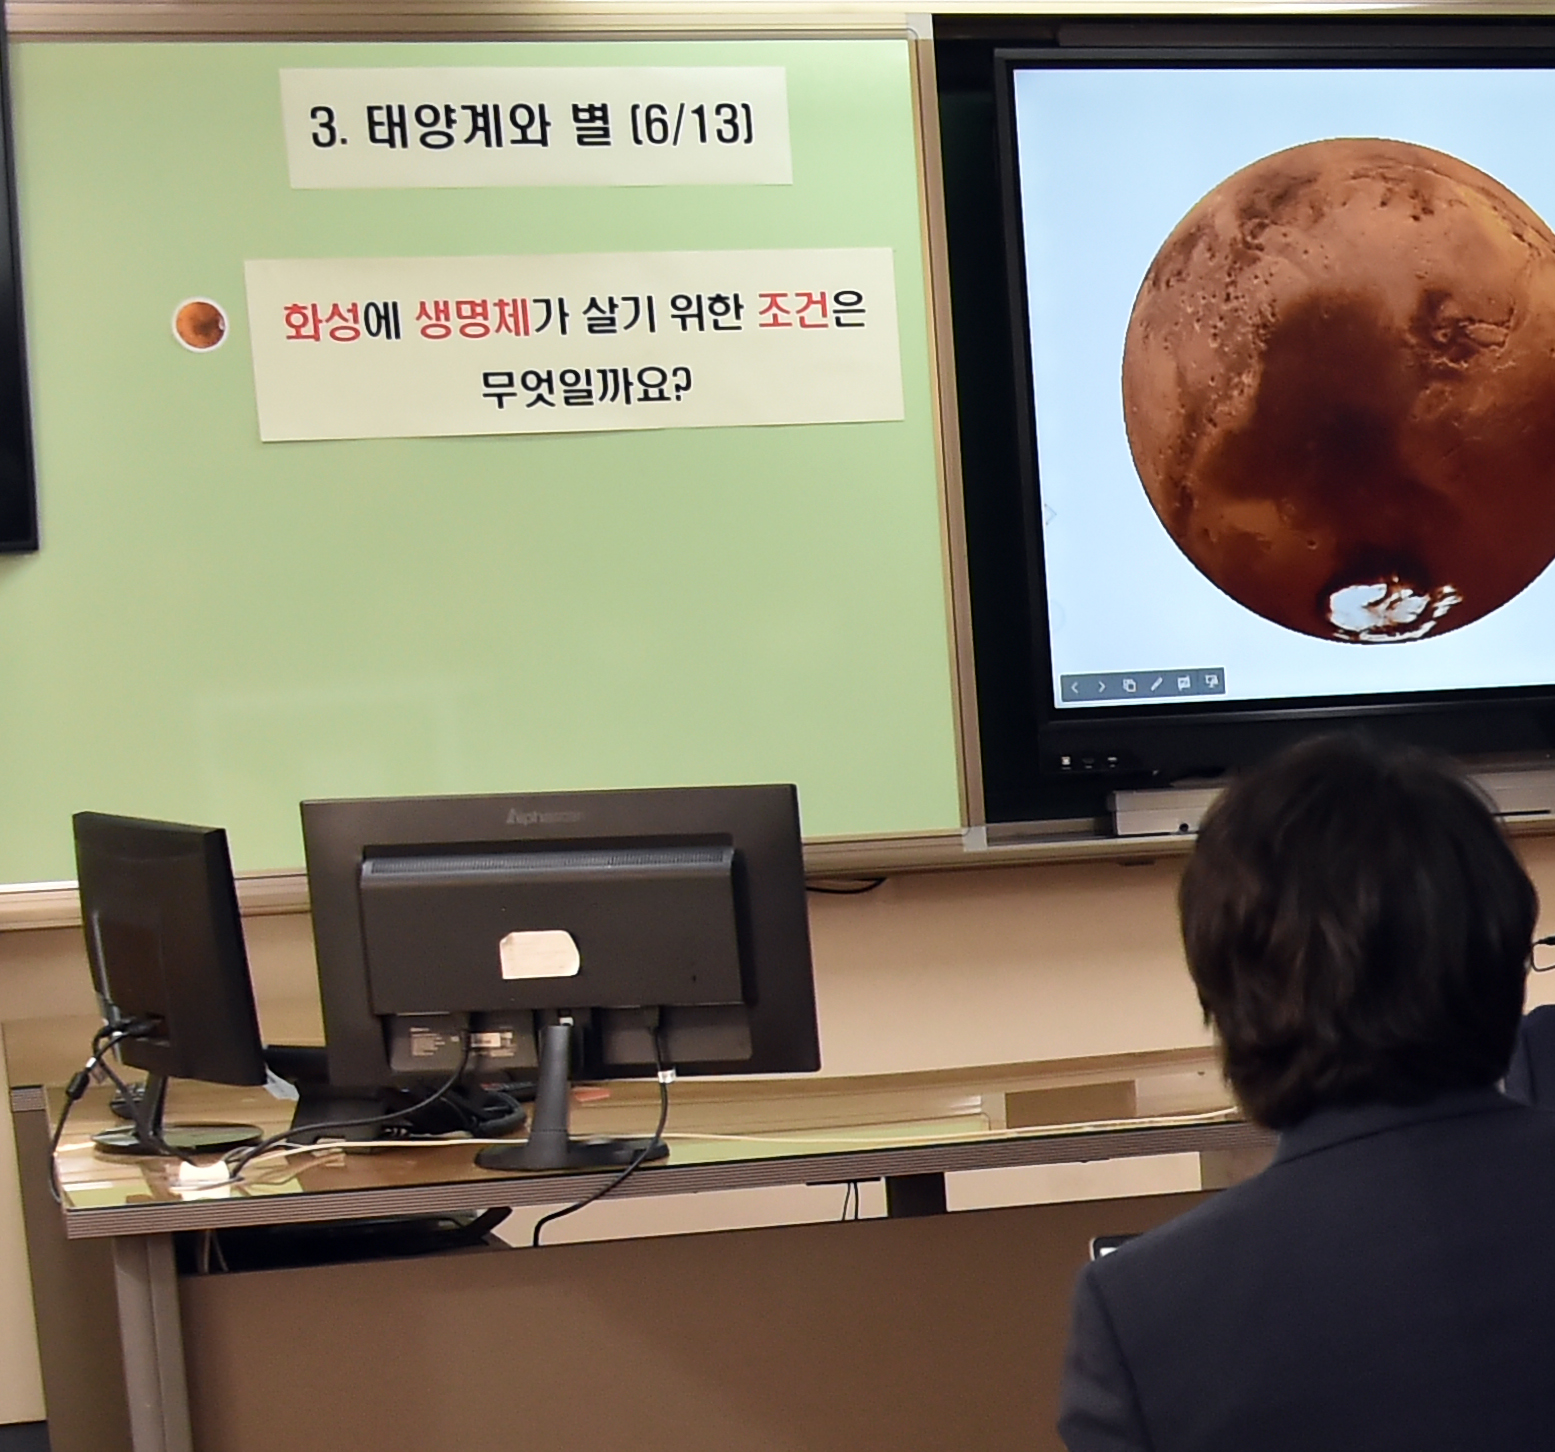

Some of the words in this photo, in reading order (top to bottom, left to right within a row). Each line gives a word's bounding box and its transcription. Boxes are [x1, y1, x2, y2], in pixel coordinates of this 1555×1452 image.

[310, 105, 348, 149] 3.
[366, 102, 552, 150] 태양계와
[571, 102, 612, 147] 별
[283, 300, 402, 343] 화성에
[415, 296, 570, 340] 생명체가
[581, 295, 656, 335] 살기
[670, 292, 745, 332] 위한
[757, 290, 866, 329] 조건은
[482, 366, 692, 410] 무엇일까요?
